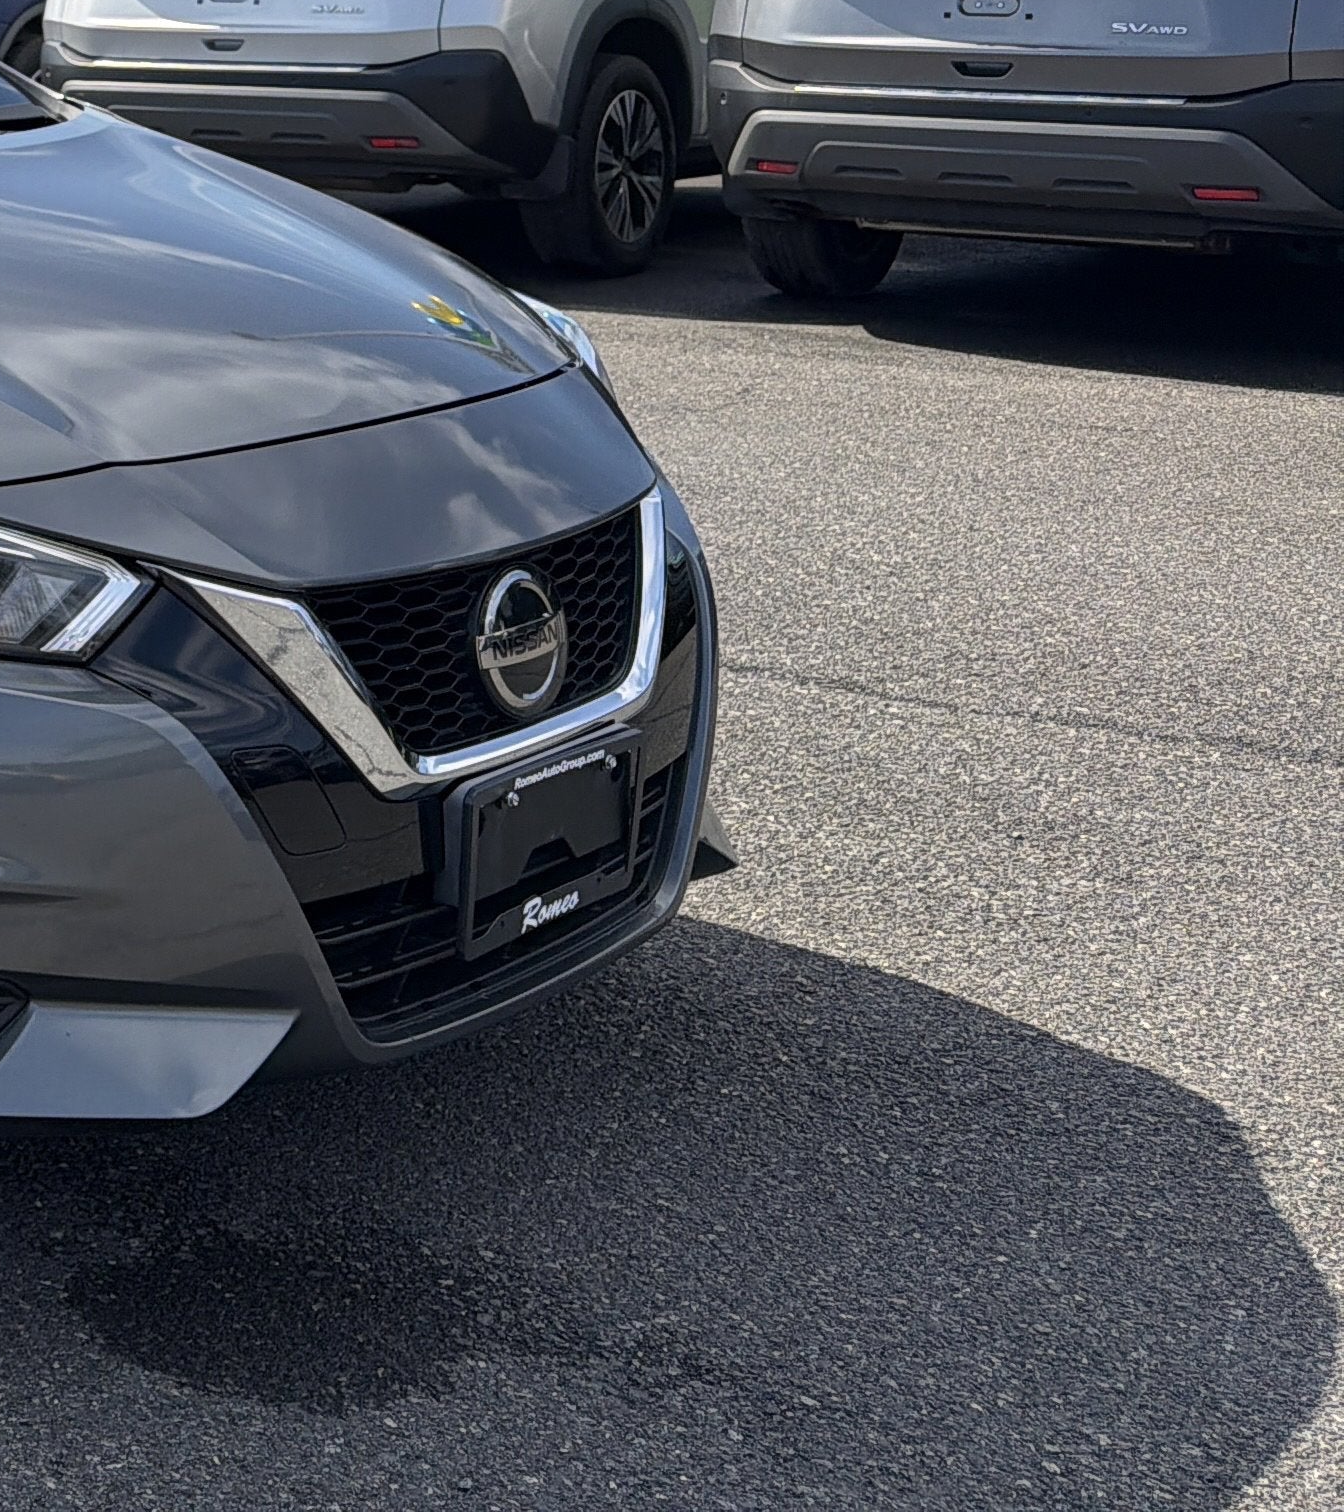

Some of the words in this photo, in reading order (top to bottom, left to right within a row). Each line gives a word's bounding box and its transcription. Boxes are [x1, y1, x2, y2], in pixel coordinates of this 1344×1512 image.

[492, 623, 558, 661] NISSAN
[514, 748, 606, 791] RomeoAutoGroup.com
[520, 890, 580, 935] Romeo
